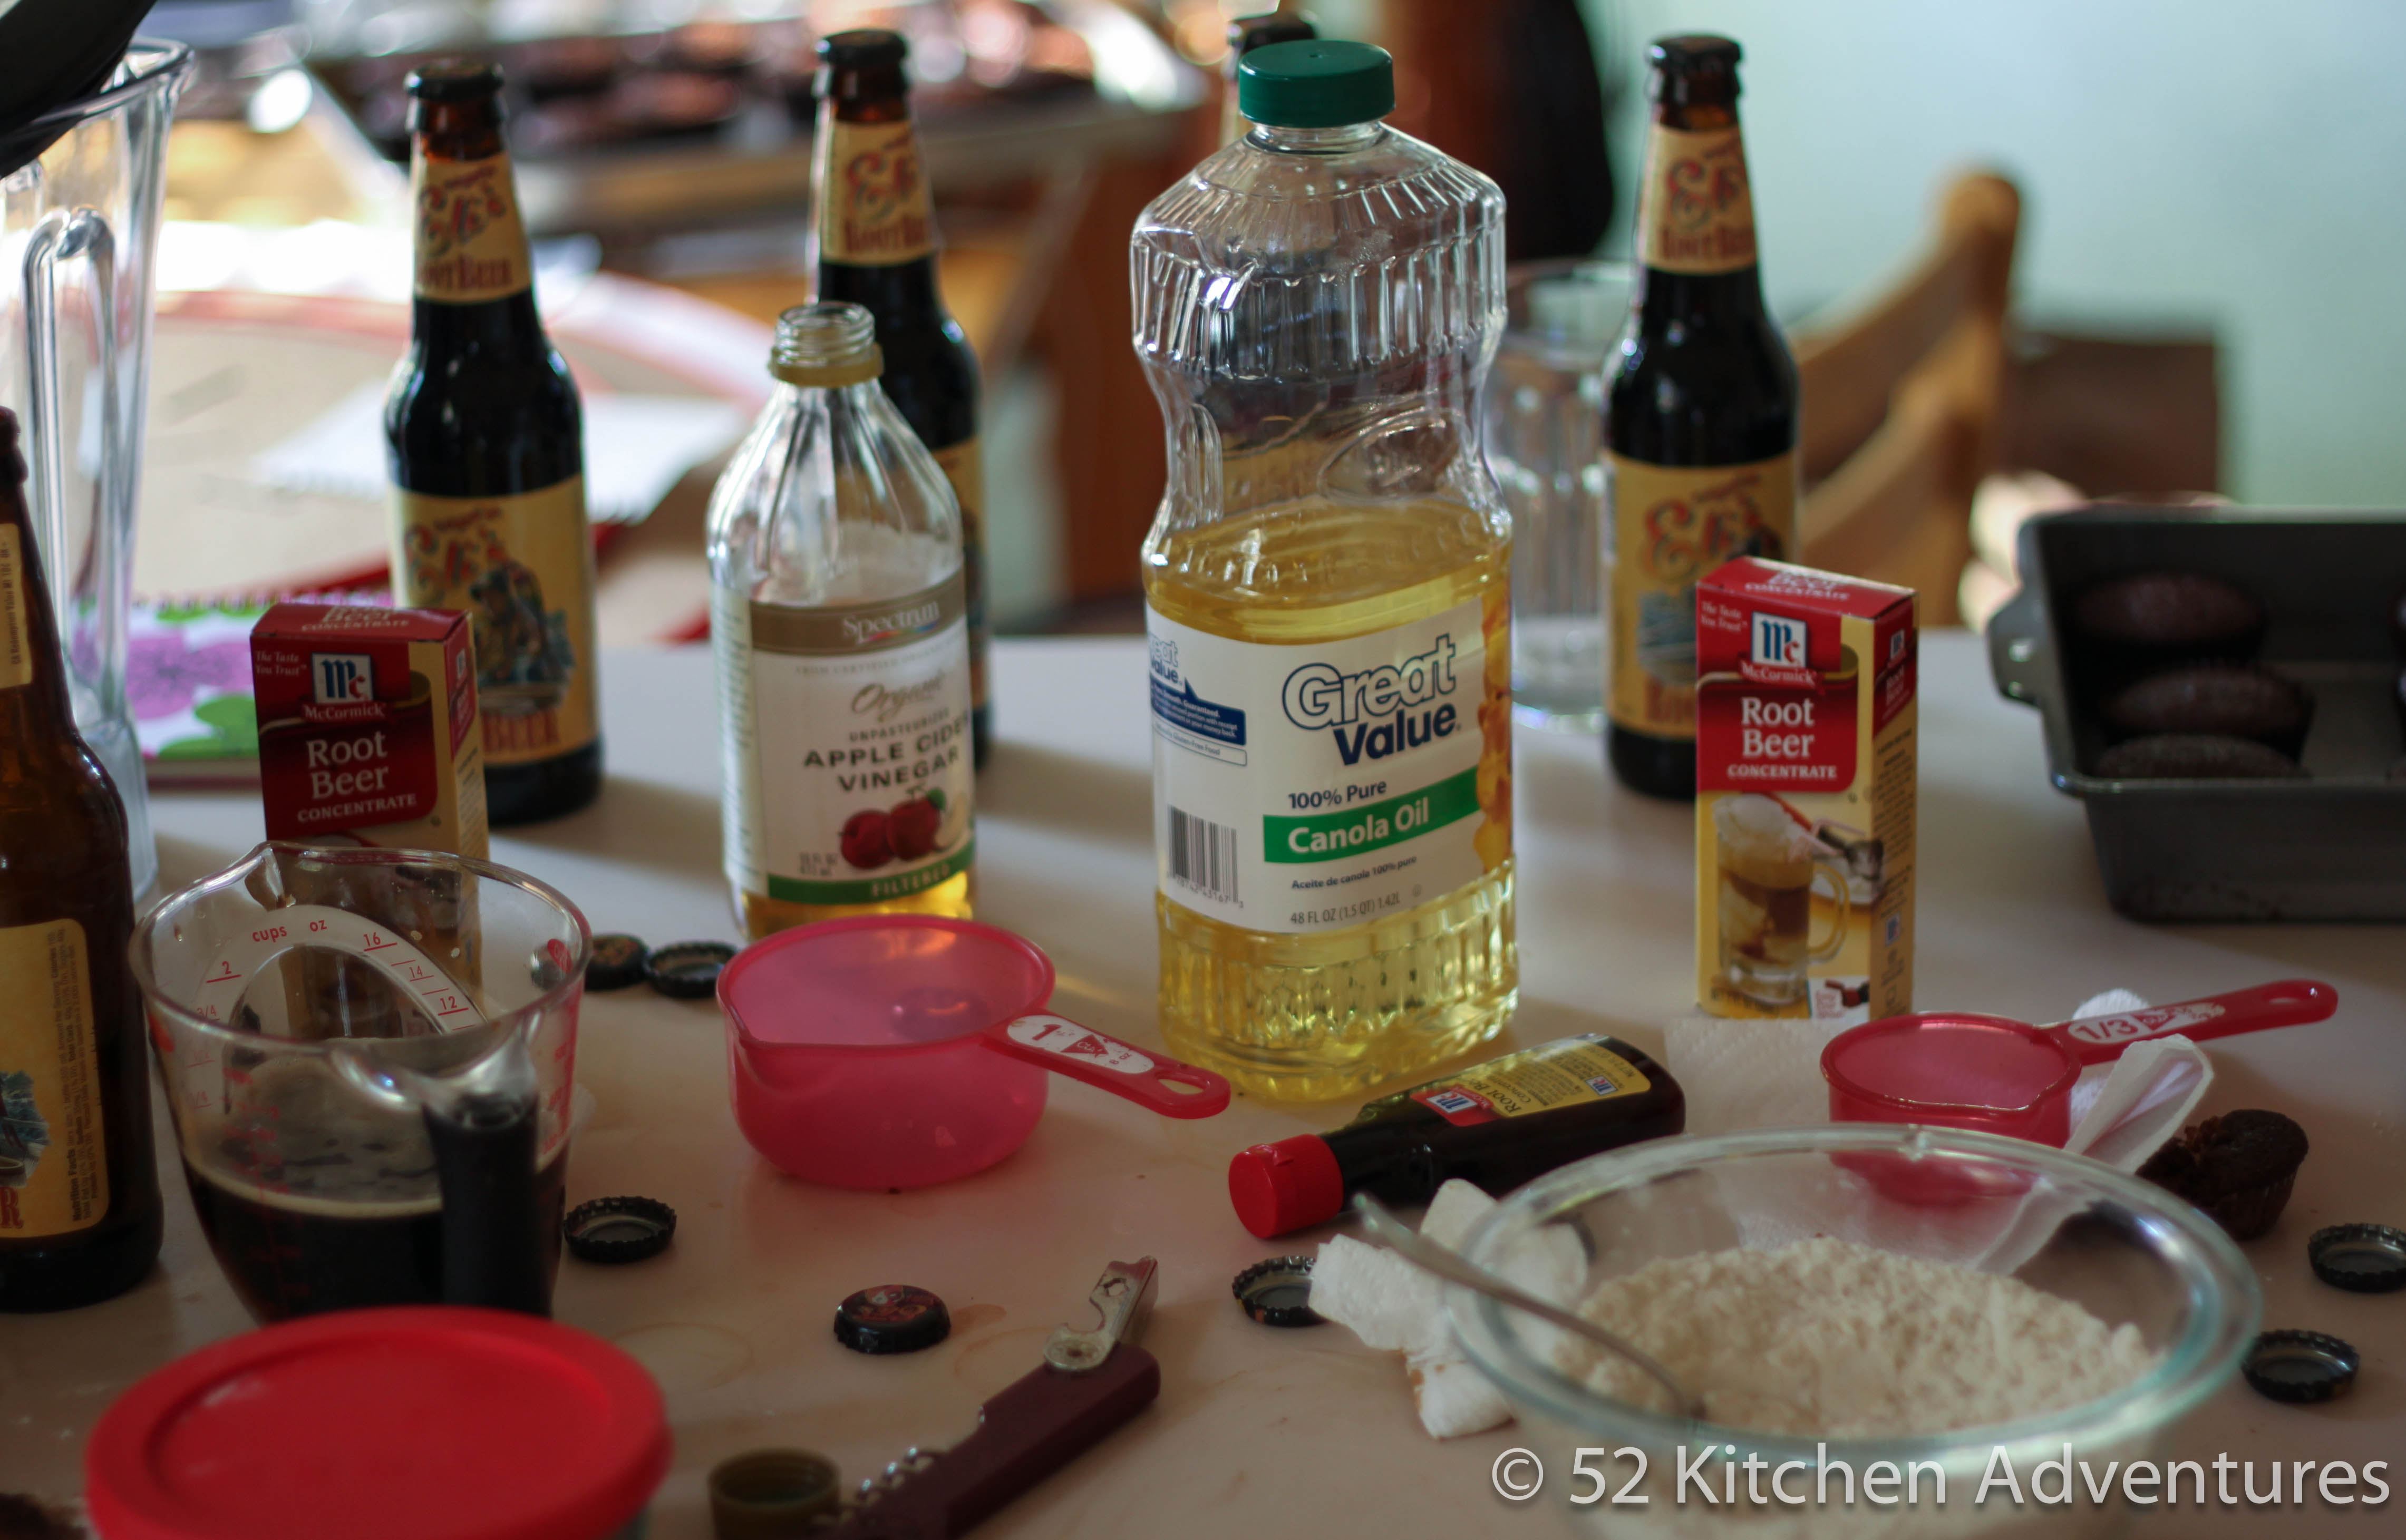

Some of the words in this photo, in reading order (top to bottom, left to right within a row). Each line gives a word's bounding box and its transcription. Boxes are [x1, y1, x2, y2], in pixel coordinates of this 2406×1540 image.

[300, 618, 410, 631] CONCENTRATE
[842, 600, 942, 644] Spectrum
[256, 650, 273, 663] The
[274, 651, 300, 664] Taste
[256, 664, 272, 676] You
[1151, 658, 1179, 684] alue
[1282, 633, 1457, 731] Great
[1740, 696, 1816, 727] Root
[1333, 703, 1457, 767] Value
[1741, 728, 1816, 759] Beer
[306, 730, 388, 769] Root
[803, 742, 904, 767] APPLE
[310, 765, 389, 800] Beer
[838, 746, 959, 792] VINEGAR
[1726, 764, 1838, 781] CONCENTRATE
[297, 792, 418, 824] CONCENTRATE
[1288, 787, 1343, 810] 100%
[1346, 779, 1388, 803] Pure
[1287, 813, 1390, 855] Canola
[1394, 796, 1430, 831] Oil
[872, 863, 950, 897] FILTERED
[1292, 880, 1324, 890] Aceite
[1326, 876, 1338, 886] de
[1341, 870, 1371, 884] canola
[1373, 862, 1396, 875] 100%
[1291, 912, 1305, 924] 48
[1307, 910, 1320, 923] FL
[1323, 908, 1337, 922] OZ
[1339, 903, 1357, 921] (1.5
[1359, 899, 1376, 916] QT)
[1379, 891, 1401, 909] 1.42L
[252, 925, 288, 943] cups
[309, 919, 328, 933] oz
[363, 931, 382, 948] 16
[221, 961, 232, 976] 2
[409, 964, 423, 979] 14
[439, 996, 458, 1011] 12
[1032, 1023, 1063, 1041] 1
[2075, 1018, 2139, 1040] 1/3
[1486, 1089, 1522, 1113] Root
[66, 1148, 77, 1176] Facts
[70, 1177, 82, 1222] Nutrition
